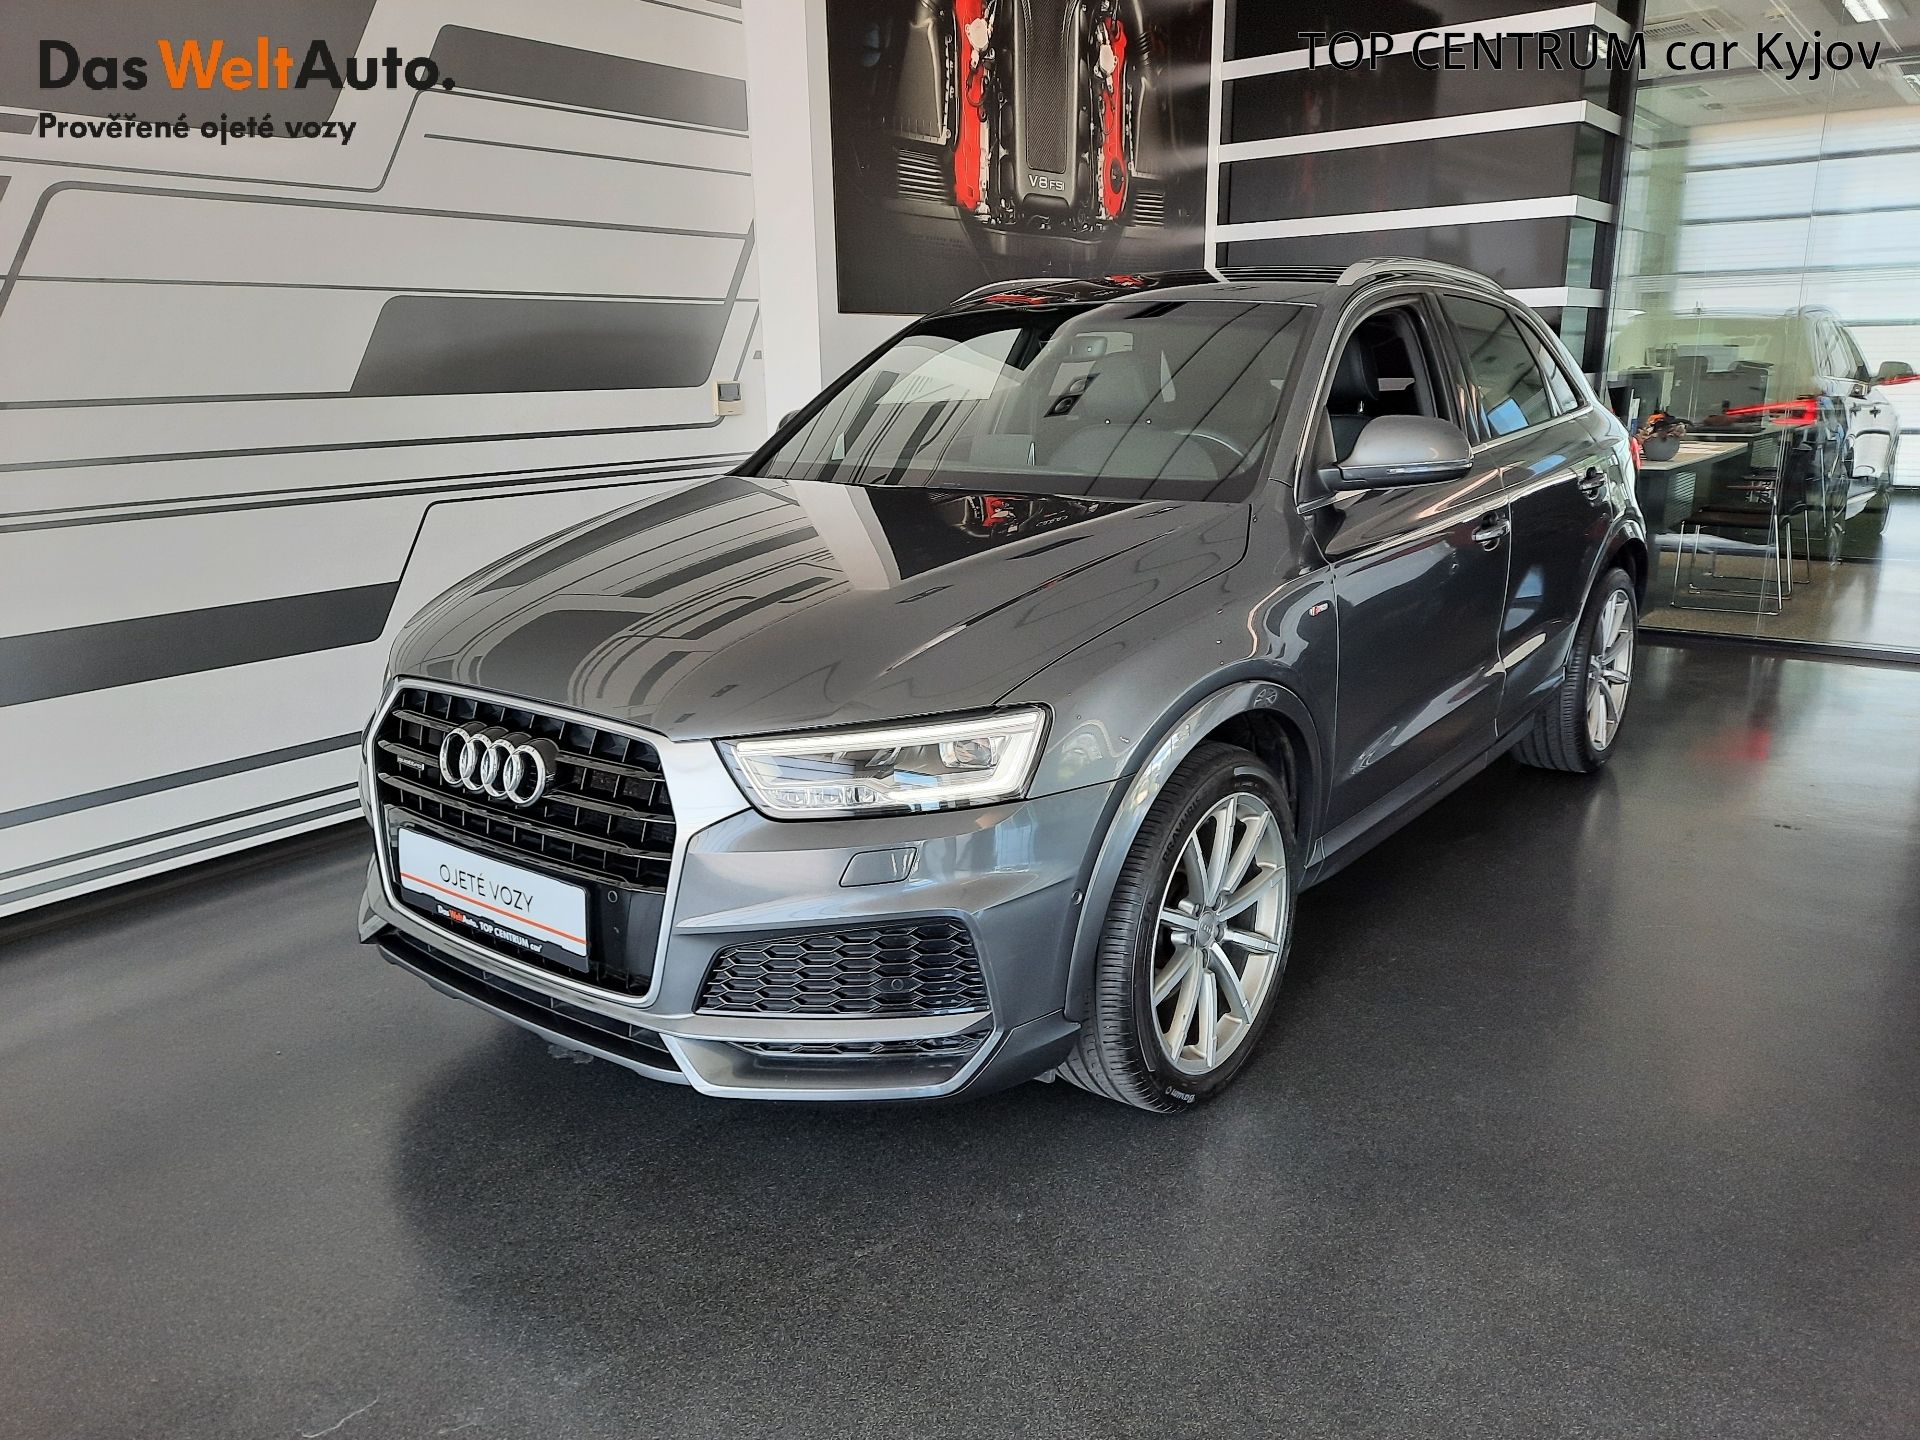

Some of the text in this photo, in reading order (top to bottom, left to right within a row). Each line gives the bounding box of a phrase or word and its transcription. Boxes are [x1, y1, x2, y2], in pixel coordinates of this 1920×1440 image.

[1028, 174, 1065, 191] V8 FSI
[439, 864, 534, 913] OJETÉ VOZY
[479, 921, 494, 934] TOP
[494, 926, 530, 949] CENTRUM
